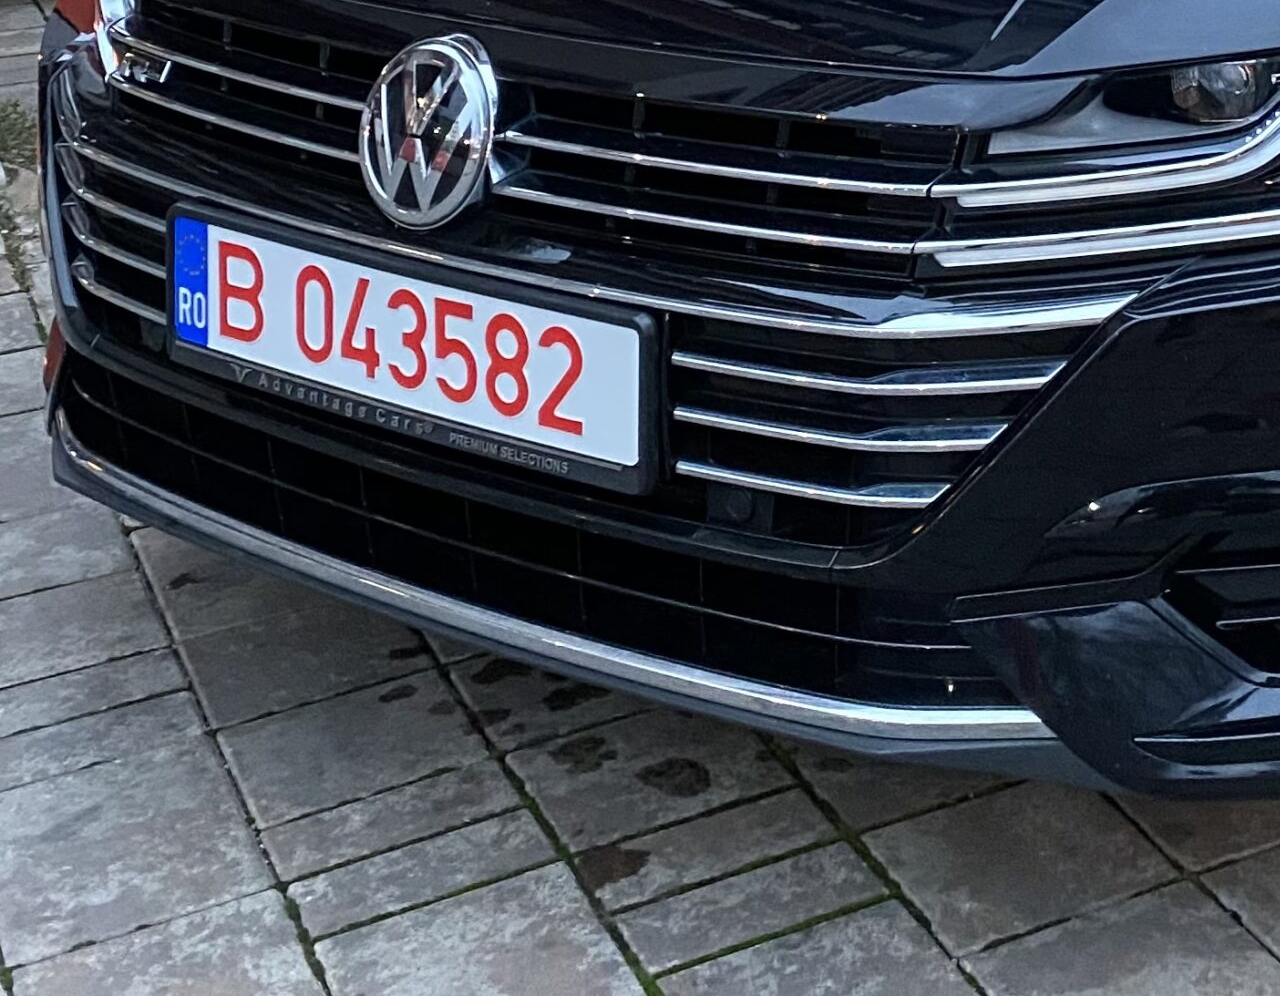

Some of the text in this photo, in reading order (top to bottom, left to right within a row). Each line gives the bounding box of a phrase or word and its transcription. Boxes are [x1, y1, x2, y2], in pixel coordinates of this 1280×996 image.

[179, 286, 207, 329] RO
[217, 239, 584, 437] B 043582
[258, 375, 367, 417] Advantage
[449, 432, 499, 458] PREMIUM
[498, 445, 569, 474] SELECTIONS
